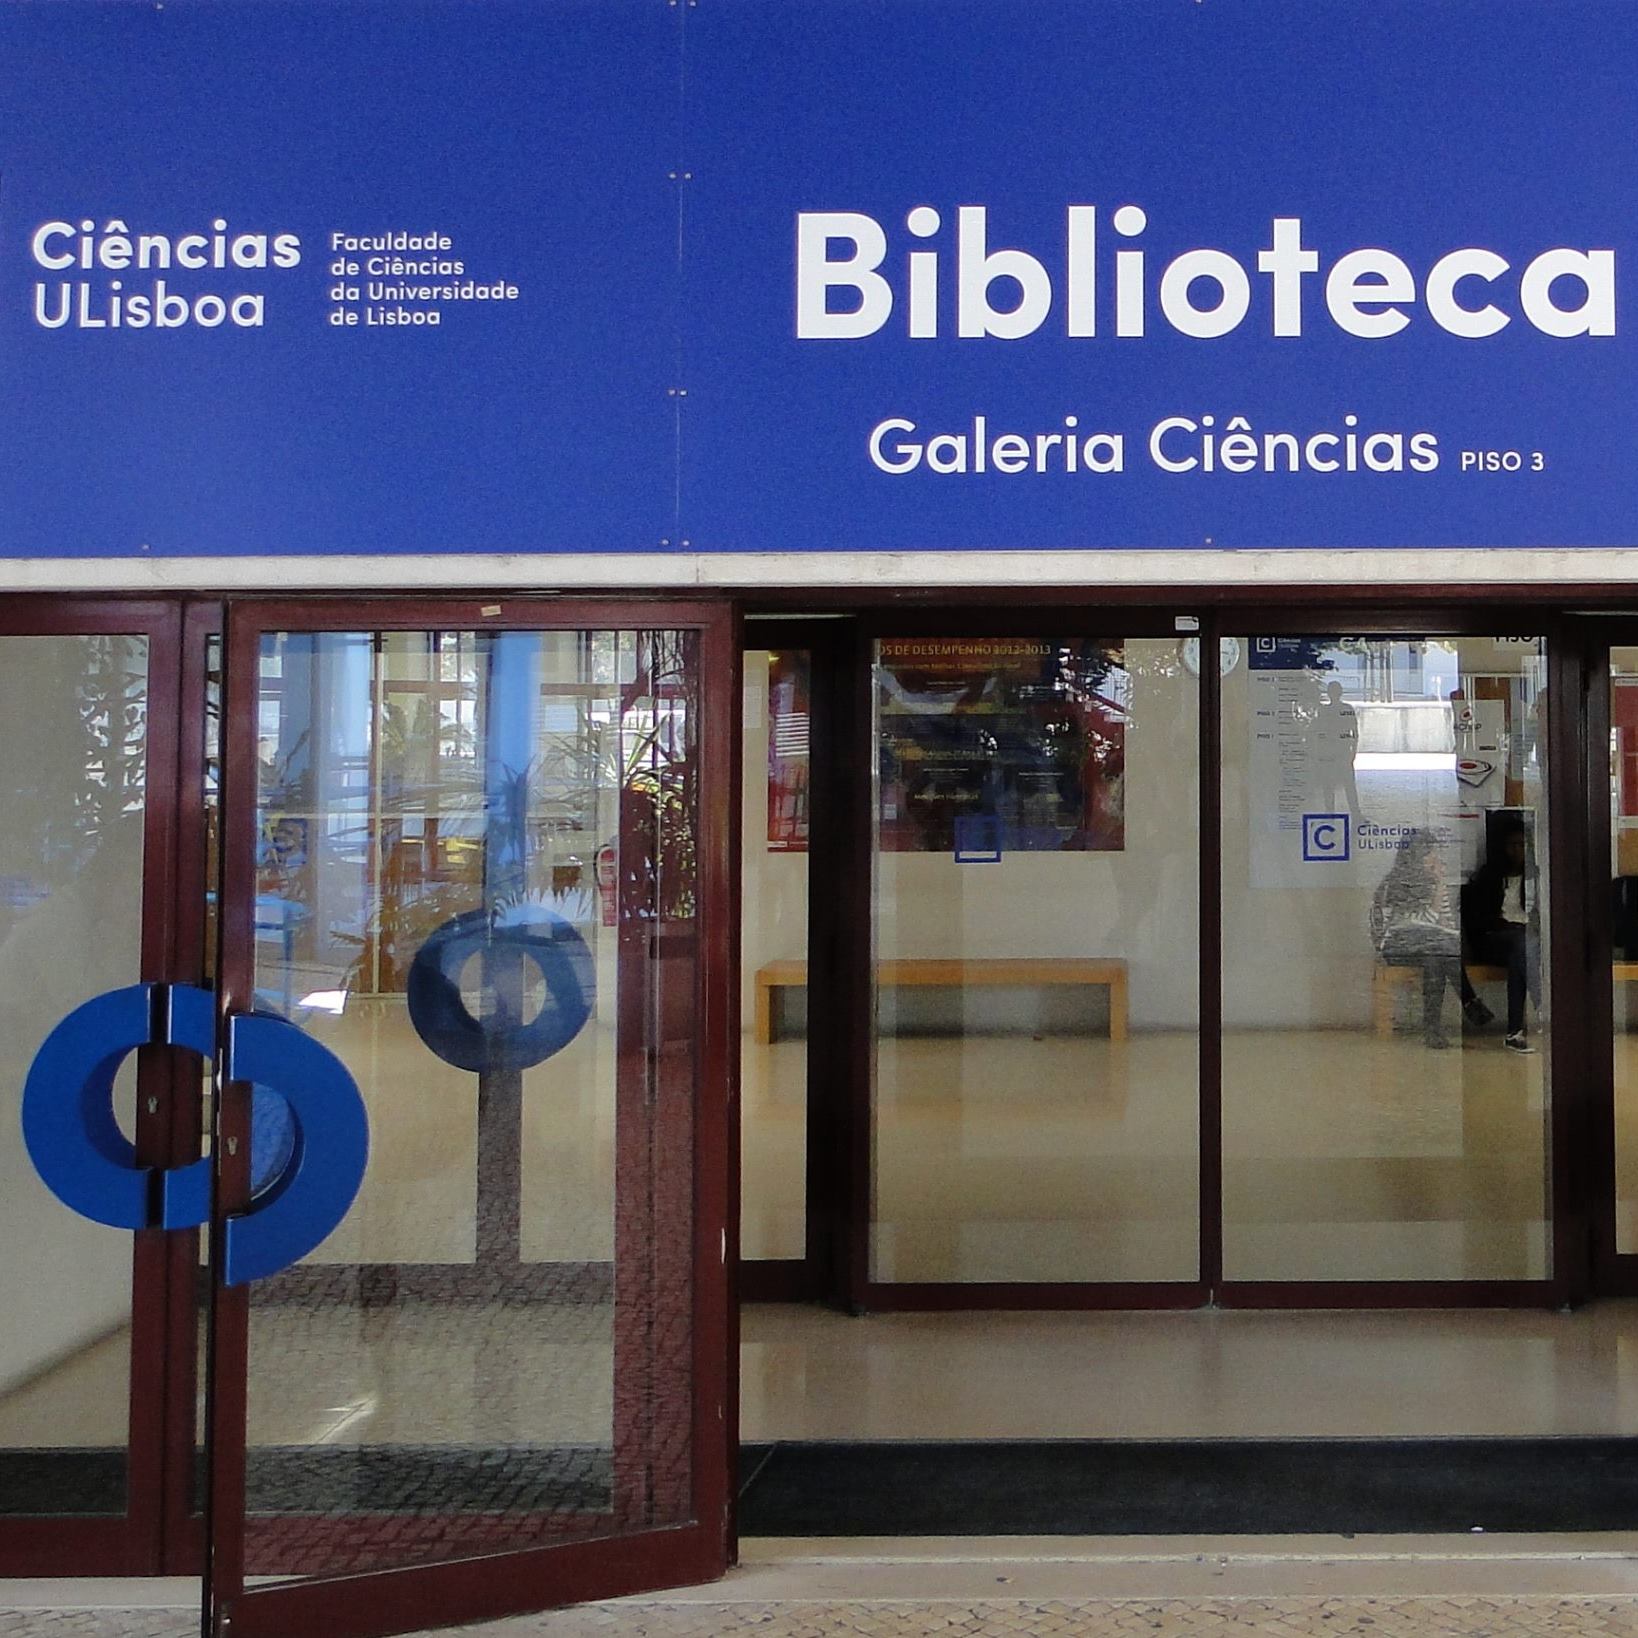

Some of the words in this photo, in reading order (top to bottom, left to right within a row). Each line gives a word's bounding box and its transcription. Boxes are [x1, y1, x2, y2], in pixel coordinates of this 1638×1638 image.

[32, 219, 301, 270] Ciências
[331, 231, 452, 251] Faculdade
[330, 256, 360, 276] de
[367, 256, 465, 276] Ciências
[797, 205, 1616, 339] Biblioteca
[330, 281, 360, 301] da
[368, 280, 519, 301] Universidade
[34, 280, 265, 329] ULisboa
[329, 306, 359, 326] de
[366, 306, 441, 326] Lisboa
[869, 415, 1124, 474] Galeria
[1149, 414, 1440, 473] Ciências
[1461, 451, 1522, 472] PISO
[1530, 451, 1544, 472] 3
[895, 644, 910, 656] DE
[912, 644, 991, 656] DESEMPENHO
